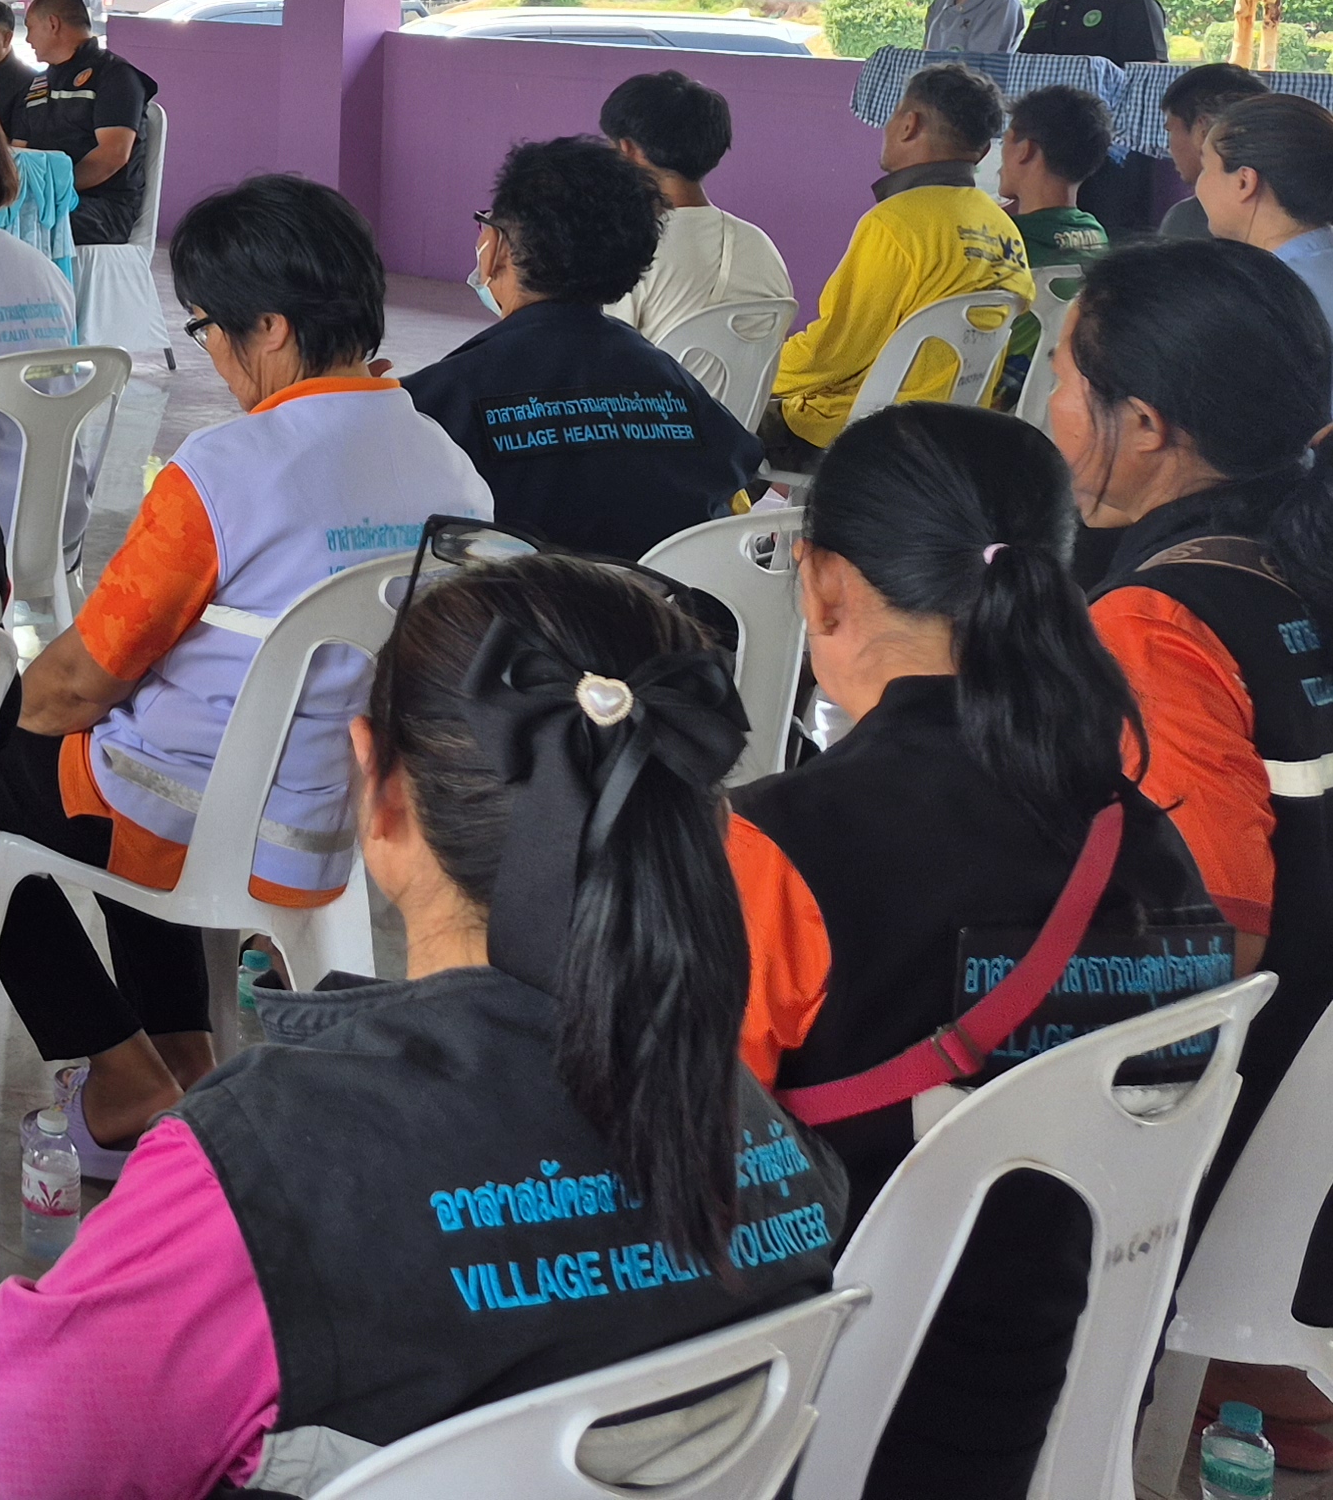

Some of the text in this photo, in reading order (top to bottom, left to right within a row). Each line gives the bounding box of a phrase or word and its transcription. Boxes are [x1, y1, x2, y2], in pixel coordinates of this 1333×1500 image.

[485, 388, 689, 427] อาสาสมัครสาธารณสุขประจำหมู่บ้าน
[491, 421, 695, 453] VILLAGE HEALTH VOLUNTEER
[449, 1250, 609, 1312] VILLAGE
[609, 1239, 712, 1293] HEAL
